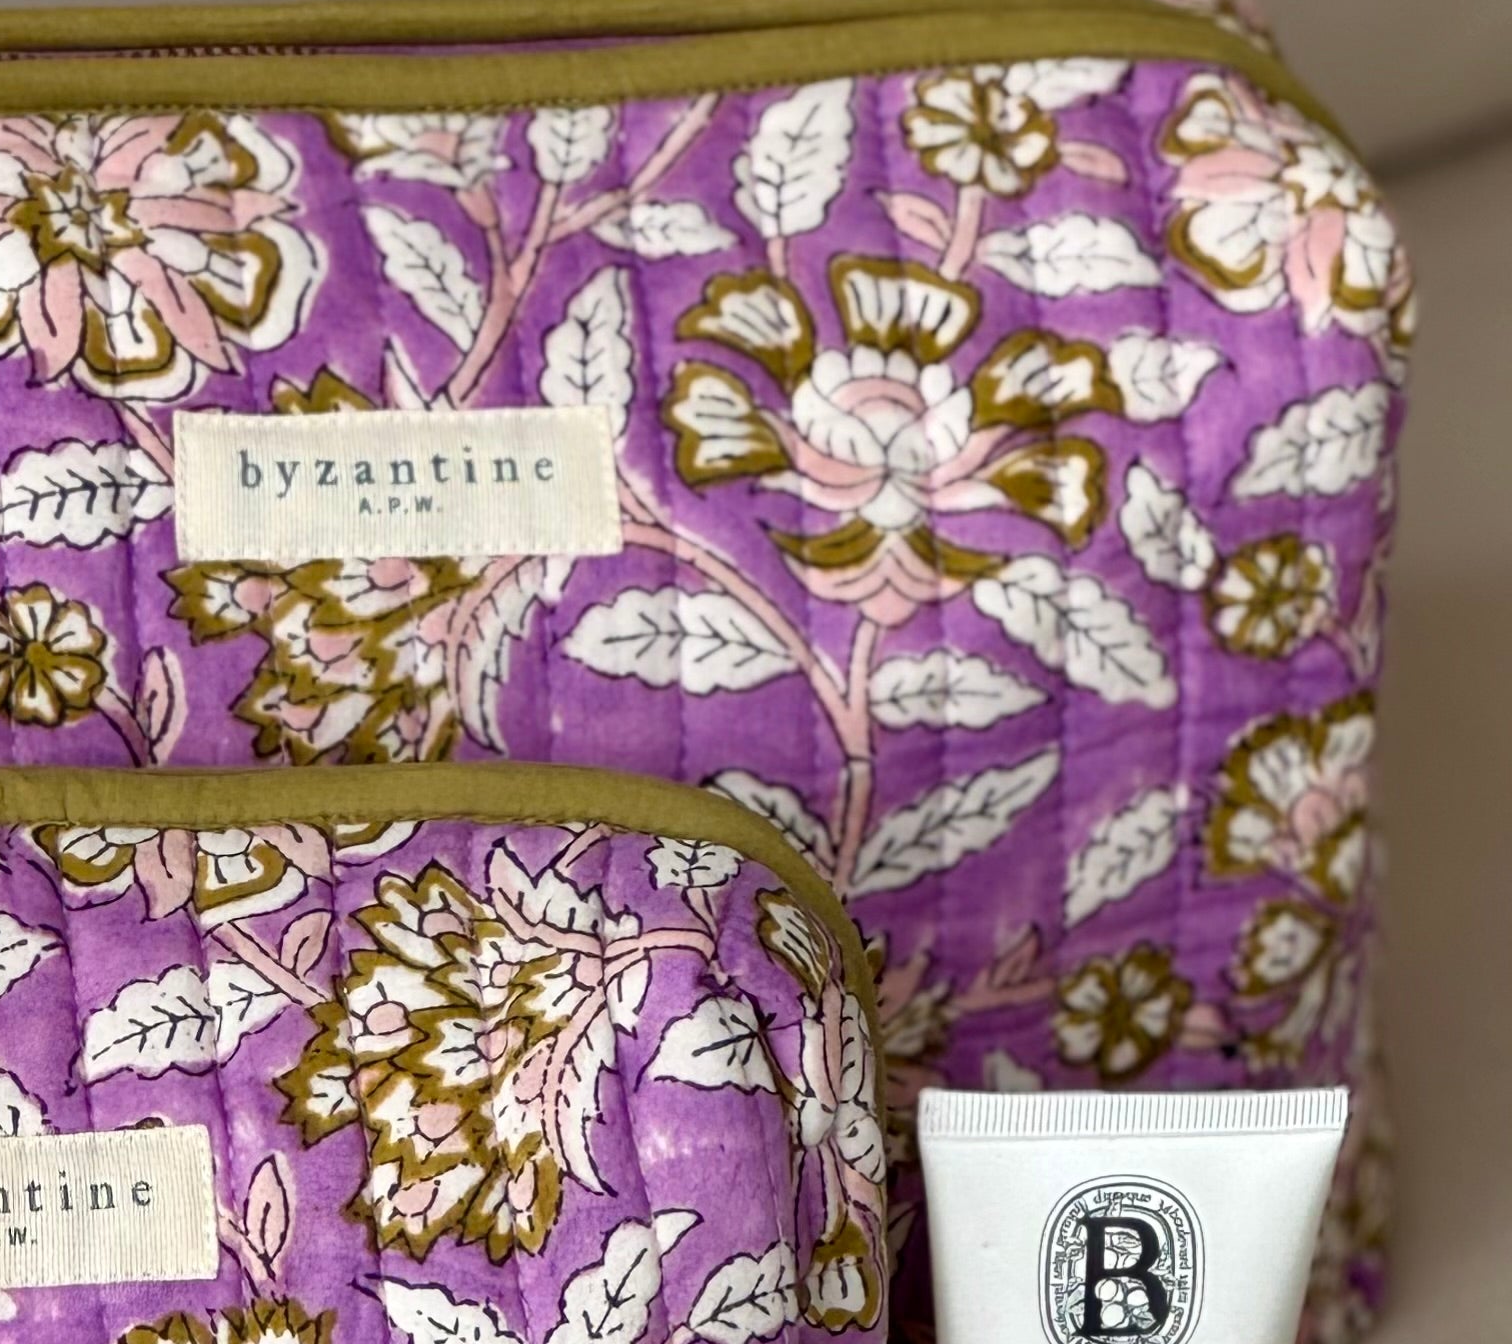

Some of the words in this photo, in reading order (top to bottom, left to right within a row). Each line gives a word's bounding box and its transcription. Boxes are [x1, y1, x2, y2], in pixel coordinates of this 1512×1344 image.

[239, 446, 555, 498] byzantine
[359, 497, 442, 515] A.P.W.
[1076, 1216, 1172, 1337] B
